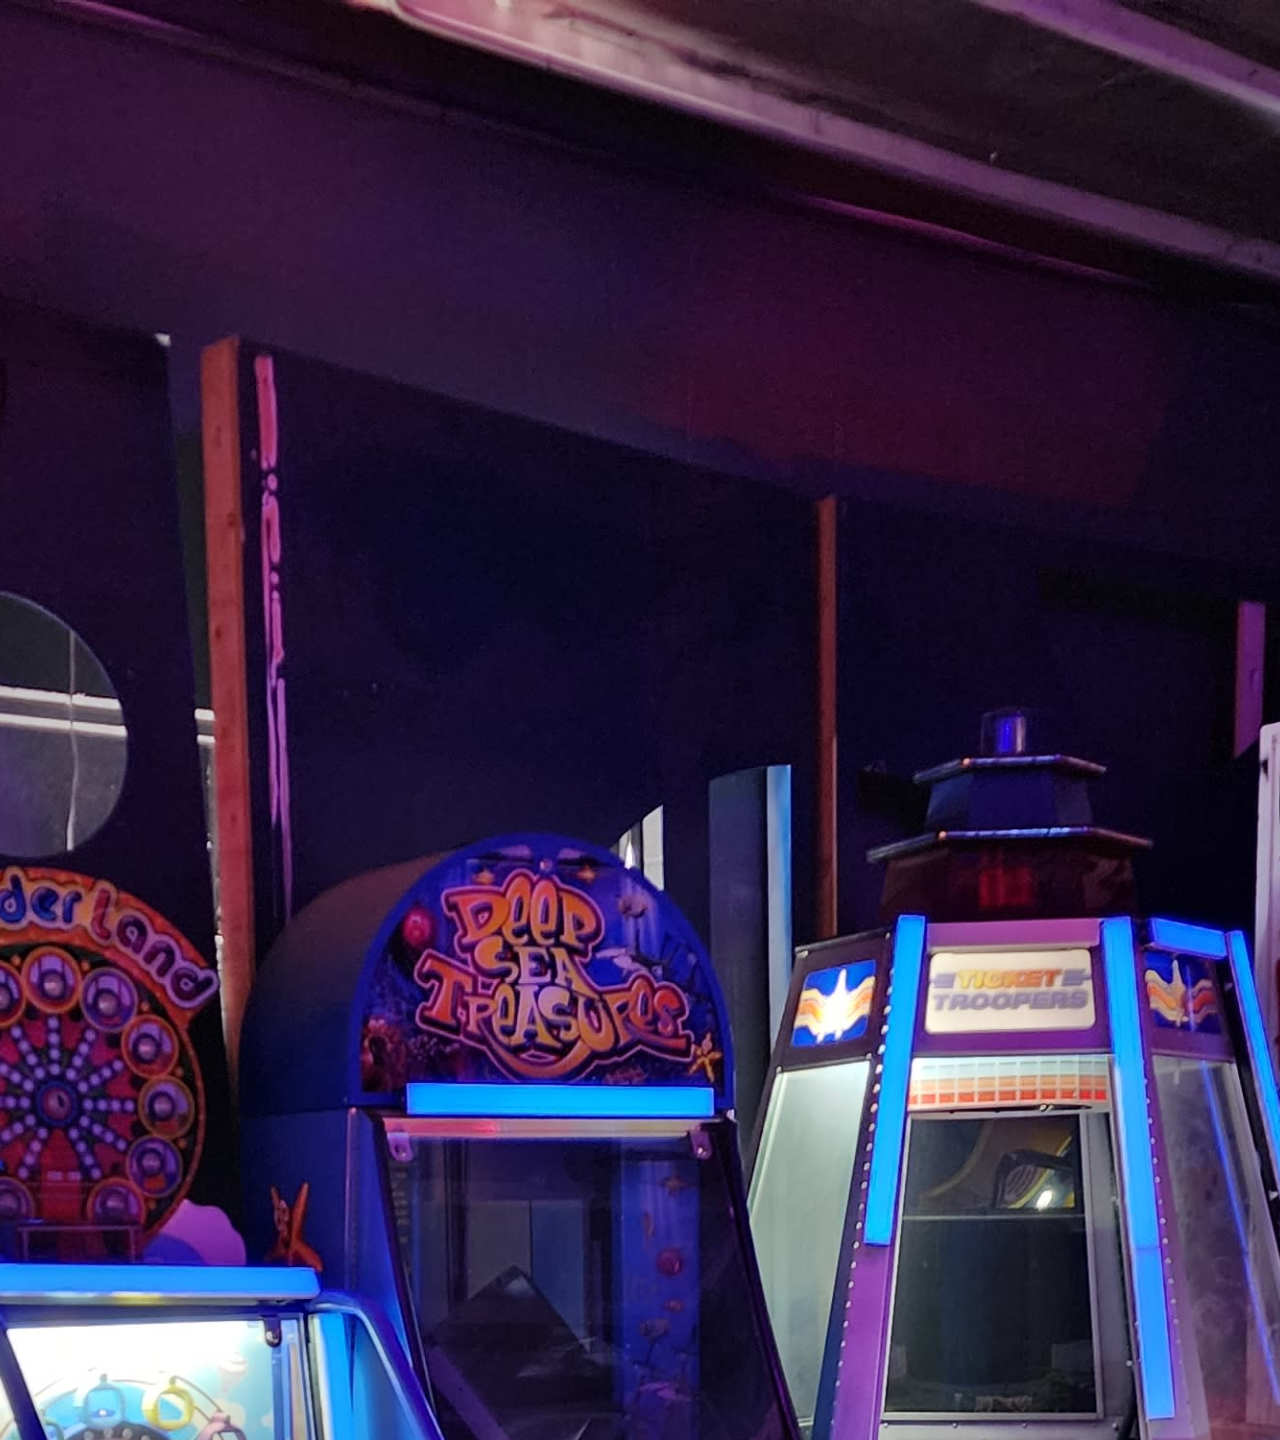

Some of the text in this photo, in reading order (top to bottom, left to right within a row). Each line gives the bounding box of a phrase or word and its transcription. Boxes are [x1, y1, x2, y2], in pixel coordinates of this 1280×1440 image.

[91, 885, 216, 1003] Land
[473, 936, 600, 998] SEA
[956, 968, 1062, 990] TICKET
[933, 989, 1090, 1011] TROOPERS
